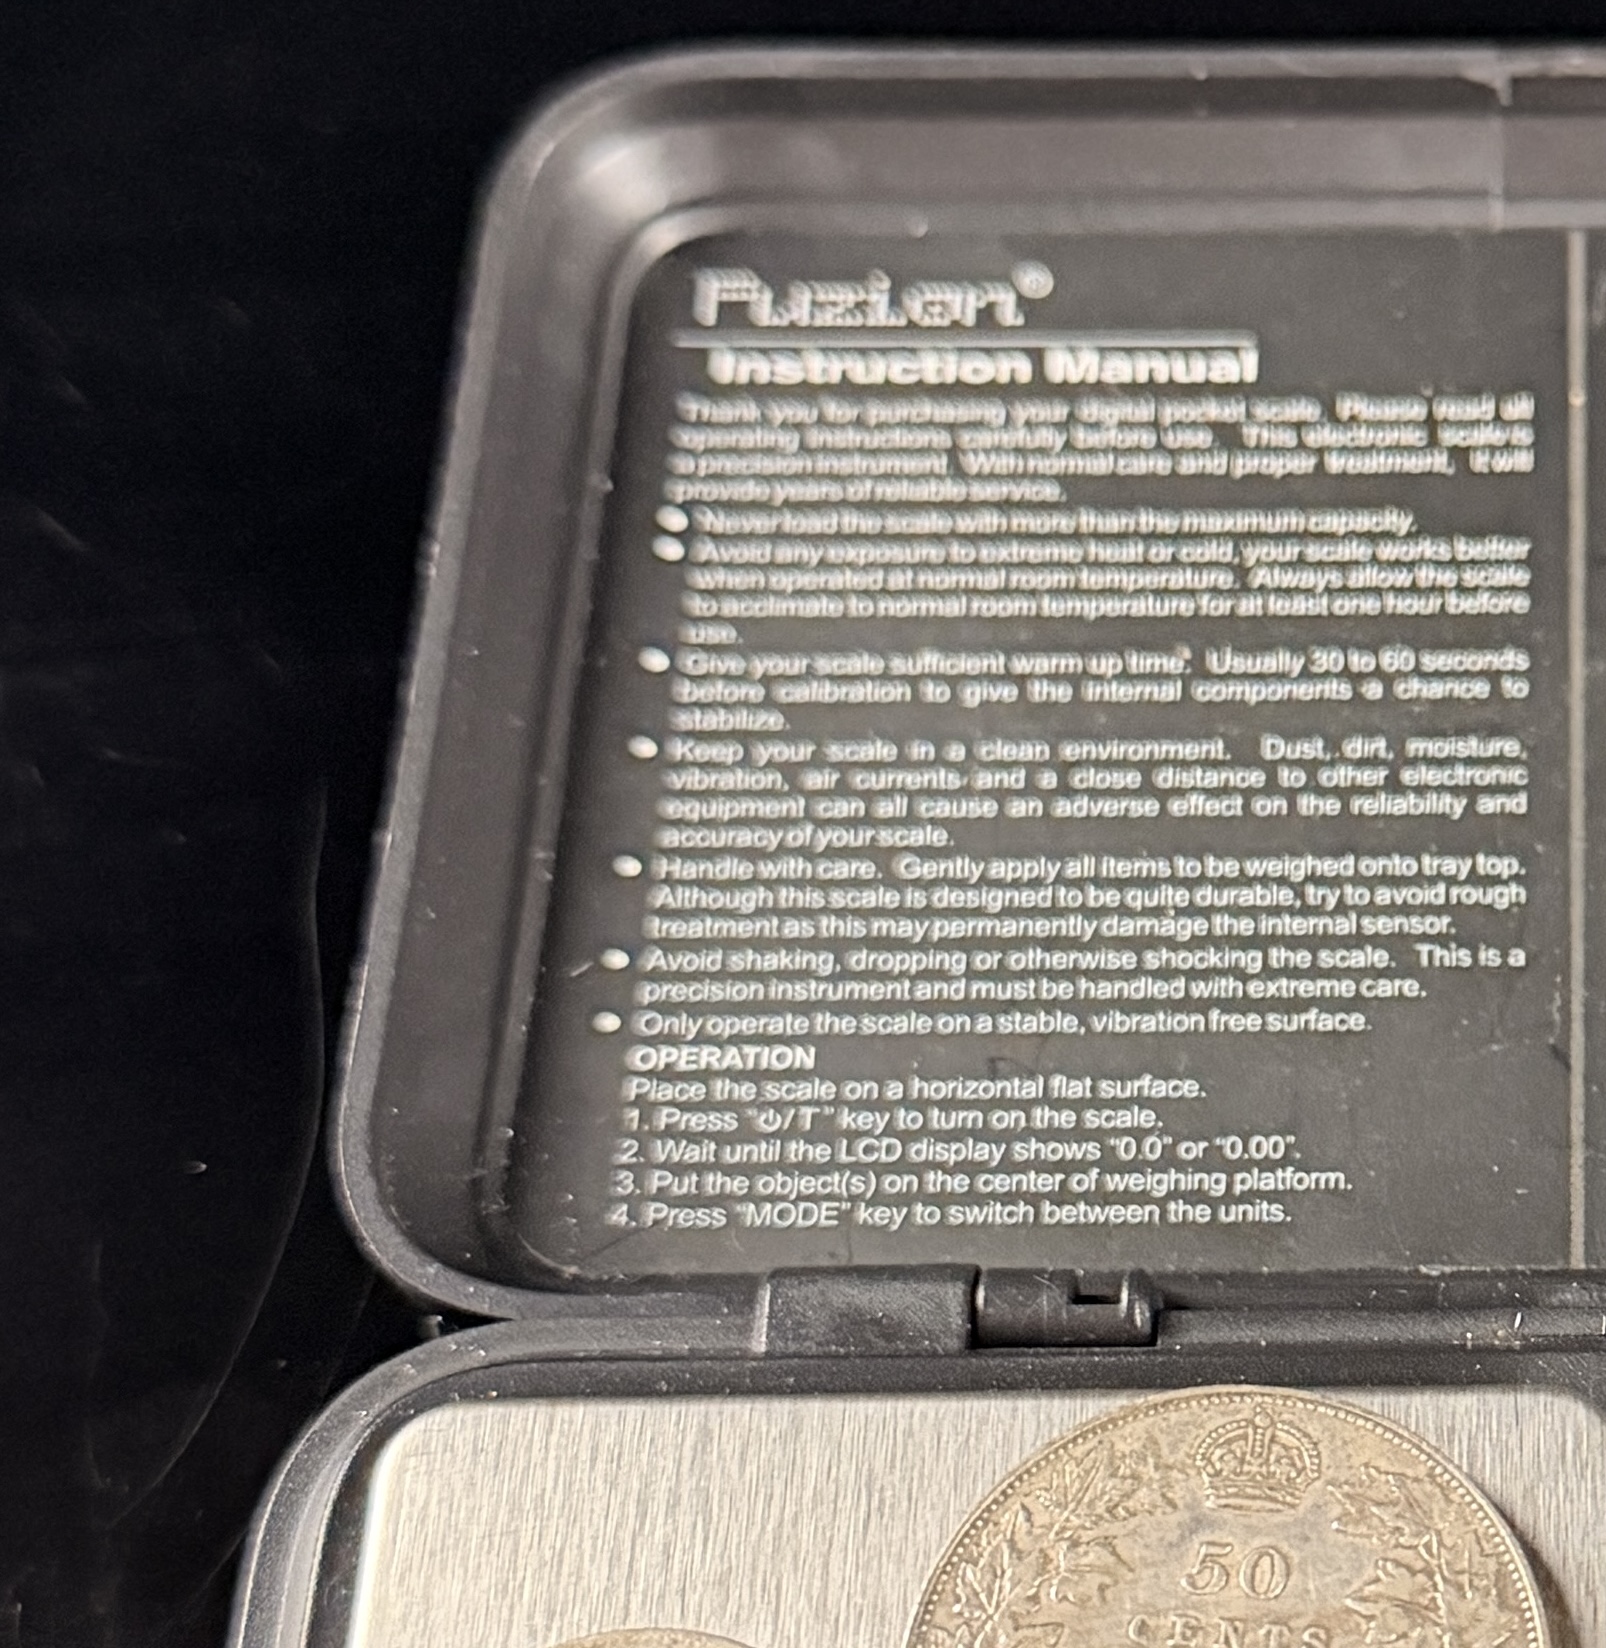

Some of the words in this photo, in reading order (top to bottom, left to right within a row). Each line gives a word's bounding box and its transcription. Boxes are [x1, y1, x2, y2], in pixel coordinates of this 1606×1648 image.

[706, 345, 1033, 385] Instruction
[1042, 344, 1260, 384] Manual
[637, 1012, 700, 1040] Only
[706, 1011, 809, 1040] operate
[814, 1011, 856, 1033] the
[861, 1011, 931, 1033] scale
[937, 1016, 970, 1033] on
[975, 1015, 992, 1033] a
[1092, 1010, 1204, 1032] vibration
[1209, 1010, 1261, 1032] free
[630, 1046, 817, 1069] OPERATION
[626, 1080, 705, 1099] Place
[711, 1079, 756, 1098] the
[761, 1079, 835, 1098] scale
[842, 1083, 878, 1098] on
[885, 1082, 903, 1098] a
[908, 1078, 1043, 1097] horizontal
[1049, 1077, 1091, 1097] flat
[654, 1107, 737, 1130] Press
[838, 1107, 889, 1136] key
[894, 1106, 922, 1129] to
[928, 1106, 983, 1129] turn
[989, 1111, 1025, 1128] on
[1031, 1106, 1076, 1128] the
[652, 1138, 715, 1162] Wait
[722, 1138, 780, 1161] until
[786, 1137, 831, 1161] the
[836, 1137, 901, 1161] LCD
[908, 1137, 1005, 1166] display
[1012, 1137, 1100, 1159] shows
[1177, 1141, 1205, 1159] or
[649, 1172, 697, 1194] Put
[704, 1172, 748, 1194] the
[755, 1171, 876, 1199] object(s)
[882, 1176, 918, 1193] on
[924, 1171, 969, 1193] the
[975, 1170, 1061, 1192] center
[1070, 1170, 1096, 1192] of
[1105, 1170, 1226, 1198] weighing
[643, 1203, 726, 1226] Press
[855, 1202, 906, 1231] key
[912, 1202, 940, 1224] to
[946, 1202, 1034, 1224] switch
[1041, 1202, 1159, 1223] between
[1167, 1201, 1211, 1223] the
[1180, 1542, 1291, 1600] 50
